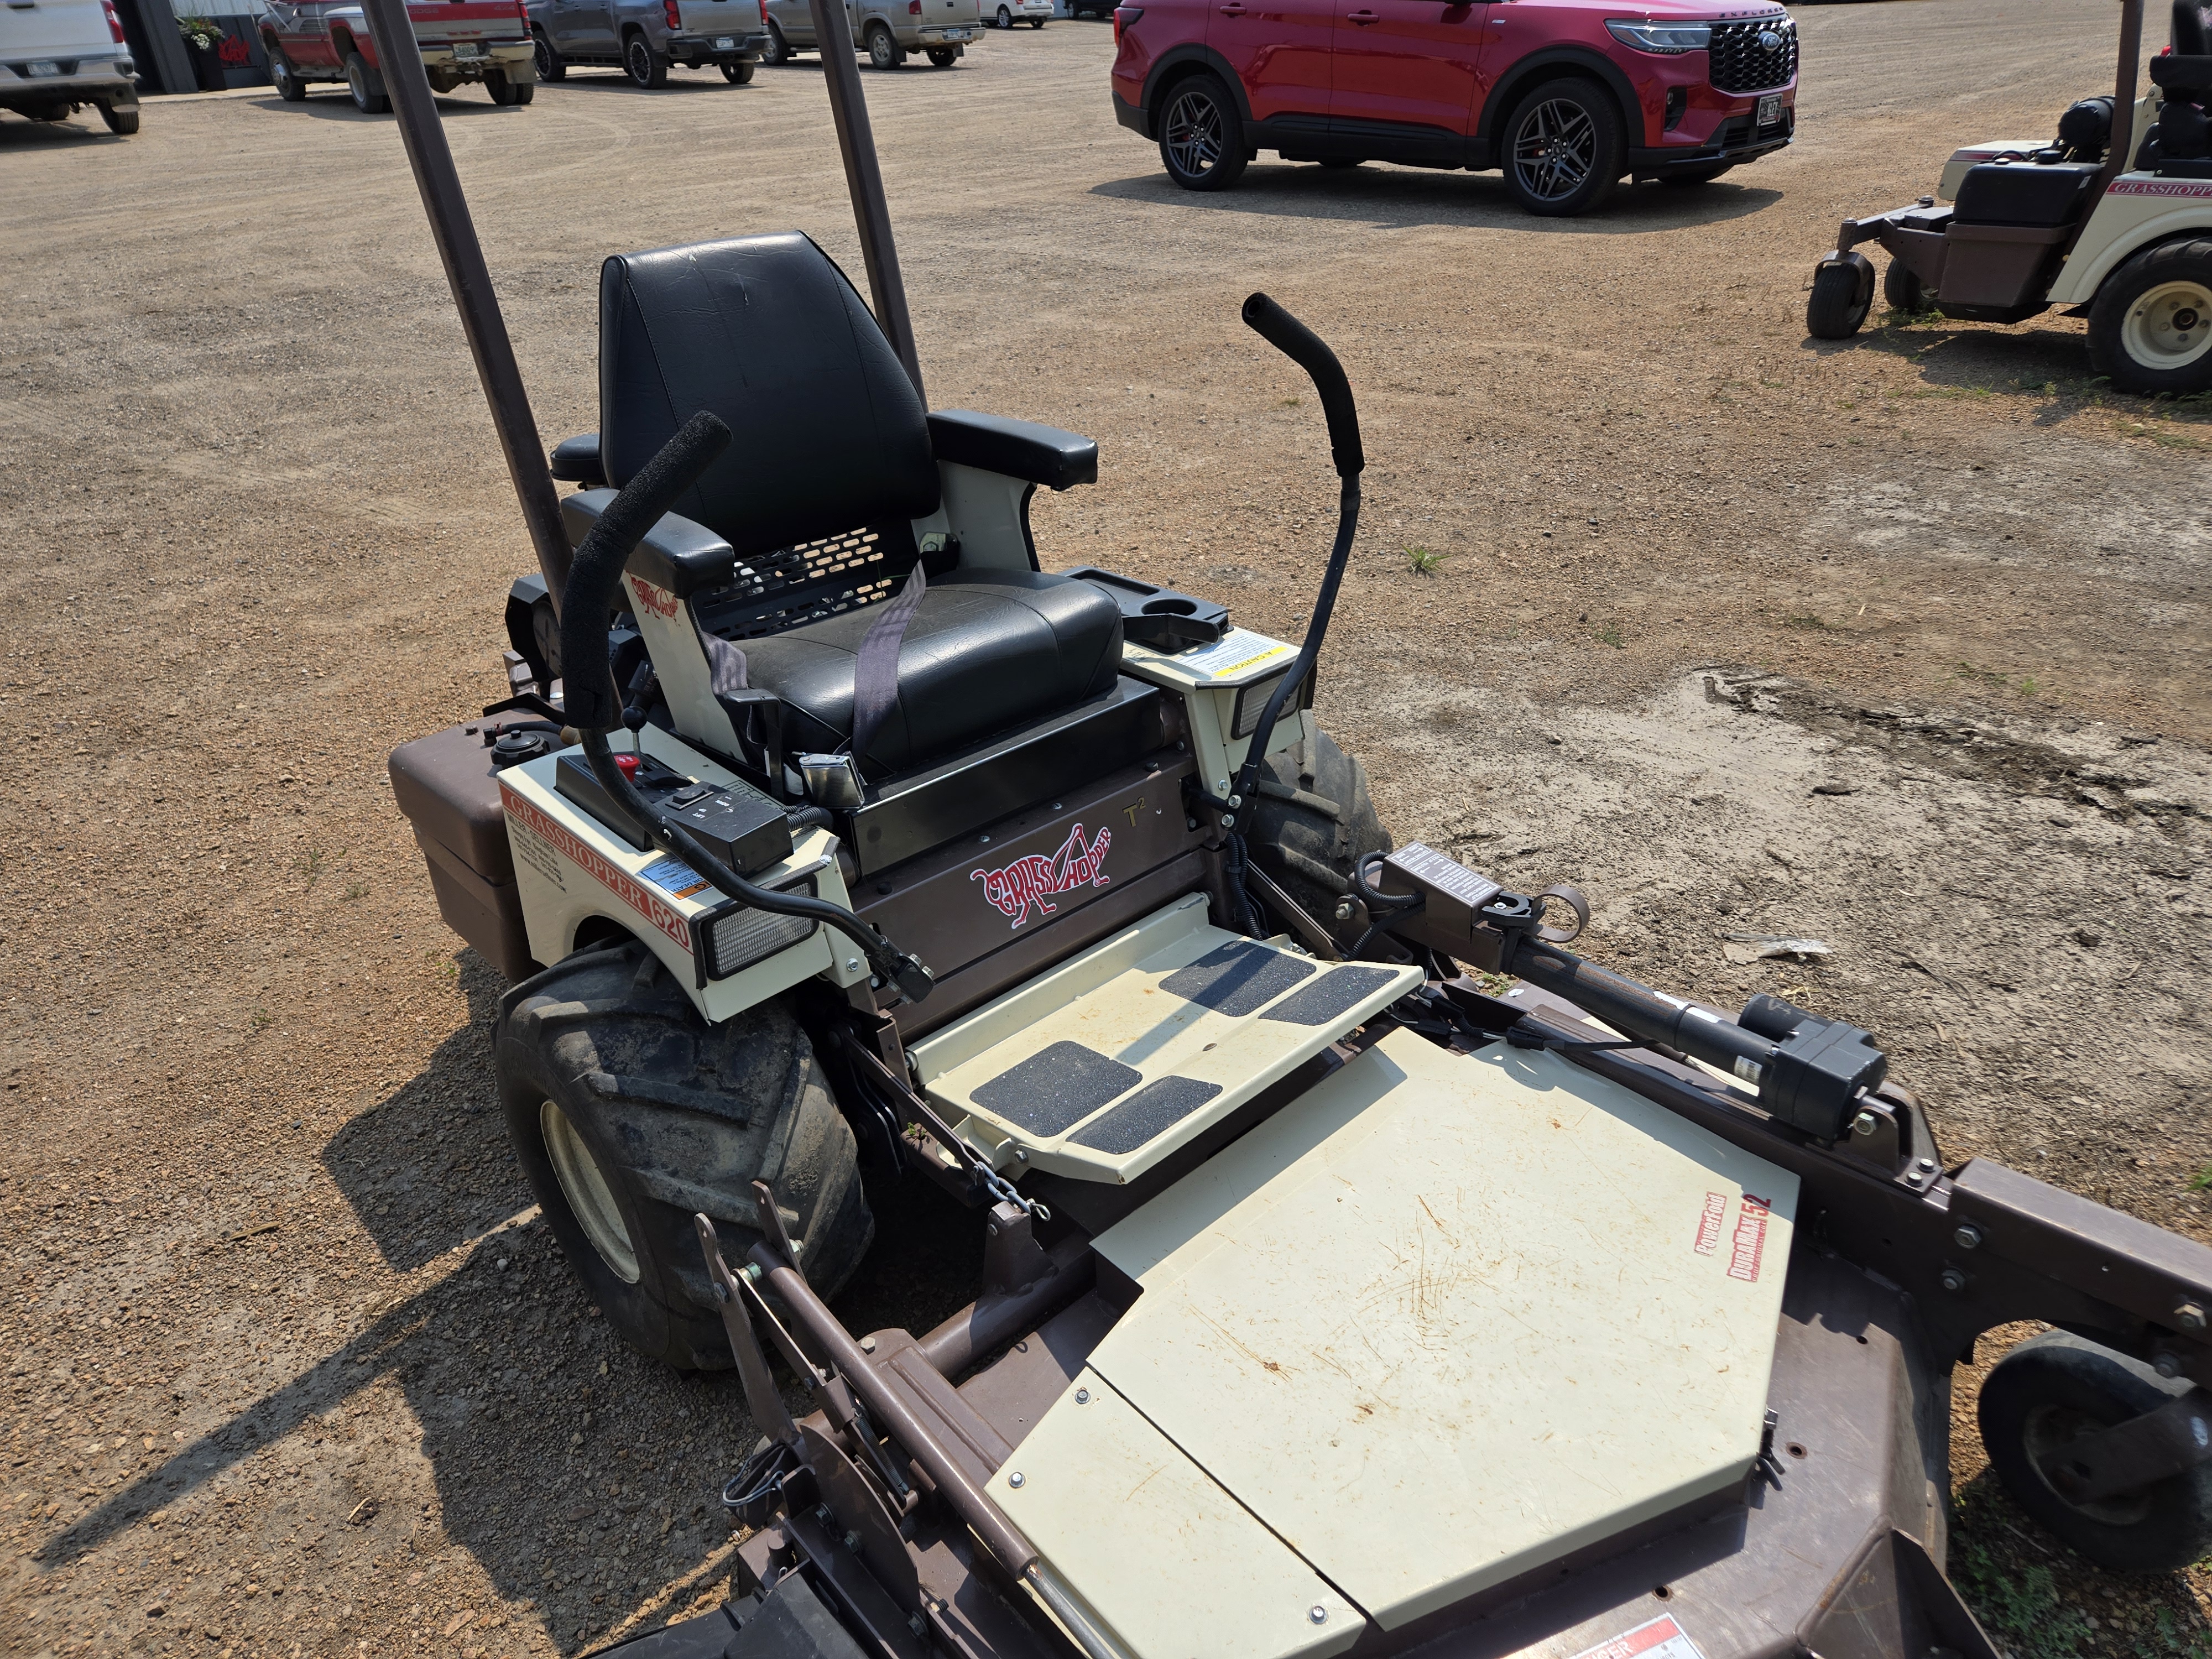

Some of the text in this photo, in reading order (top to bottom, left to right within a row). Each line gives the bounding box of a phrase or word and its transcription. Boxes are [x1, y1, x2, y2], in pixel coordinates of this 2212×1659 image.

[1719, 7, 1783, 18] EXPLORER
[2114, 183, 2212, 196] GRASSHOPP
[1229, 655, 1266, 671] CAUTION
[507, 813, 528, 834] MILLER
[530, 830, 556, 856] SELLNER
[510, 795, 690, 948] GRASSHOPPER 620
[984, 824, 1110, 915] GRASSHOPPER
[670, 882, 692, 893] DEATH
[1741, 1194, 1771, 1217] 52
[1695, 1193, 1726, 1255] PowerFold
